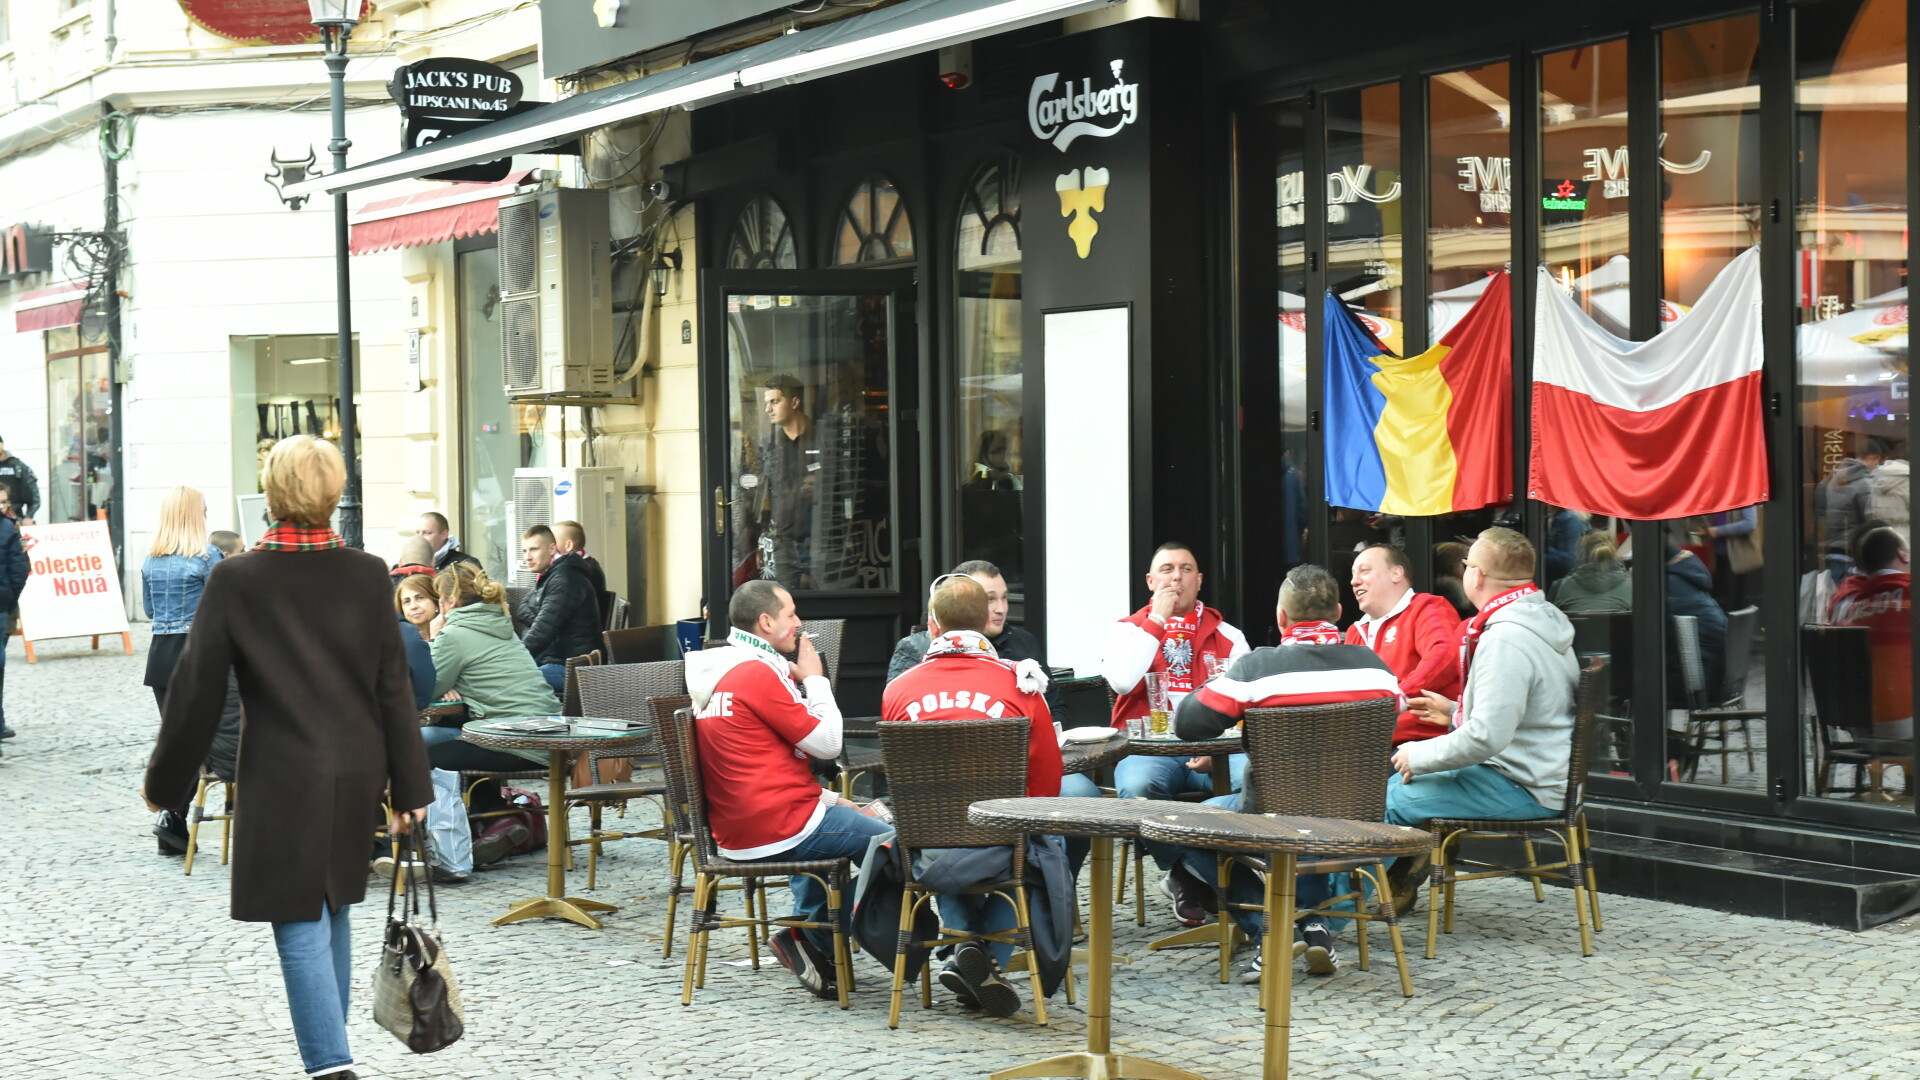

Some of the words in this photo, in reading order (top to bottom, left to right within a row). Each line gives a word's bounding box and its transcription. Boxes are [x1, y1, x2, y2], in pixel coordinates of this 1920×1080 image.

[404, 71, 468, 90] JACK'S
[472, 73, 512, 94] PUB
[409, 94, 470, 109] LIPSCANI
[471, 98, 508, 112] No.45
[1028, 71, 1139, 152] Carlsberg
[28, 553, 103, 577] olecție
[53, 572, 108, 597] Nouă
[905, 690, 1006, 722] POLSKA
